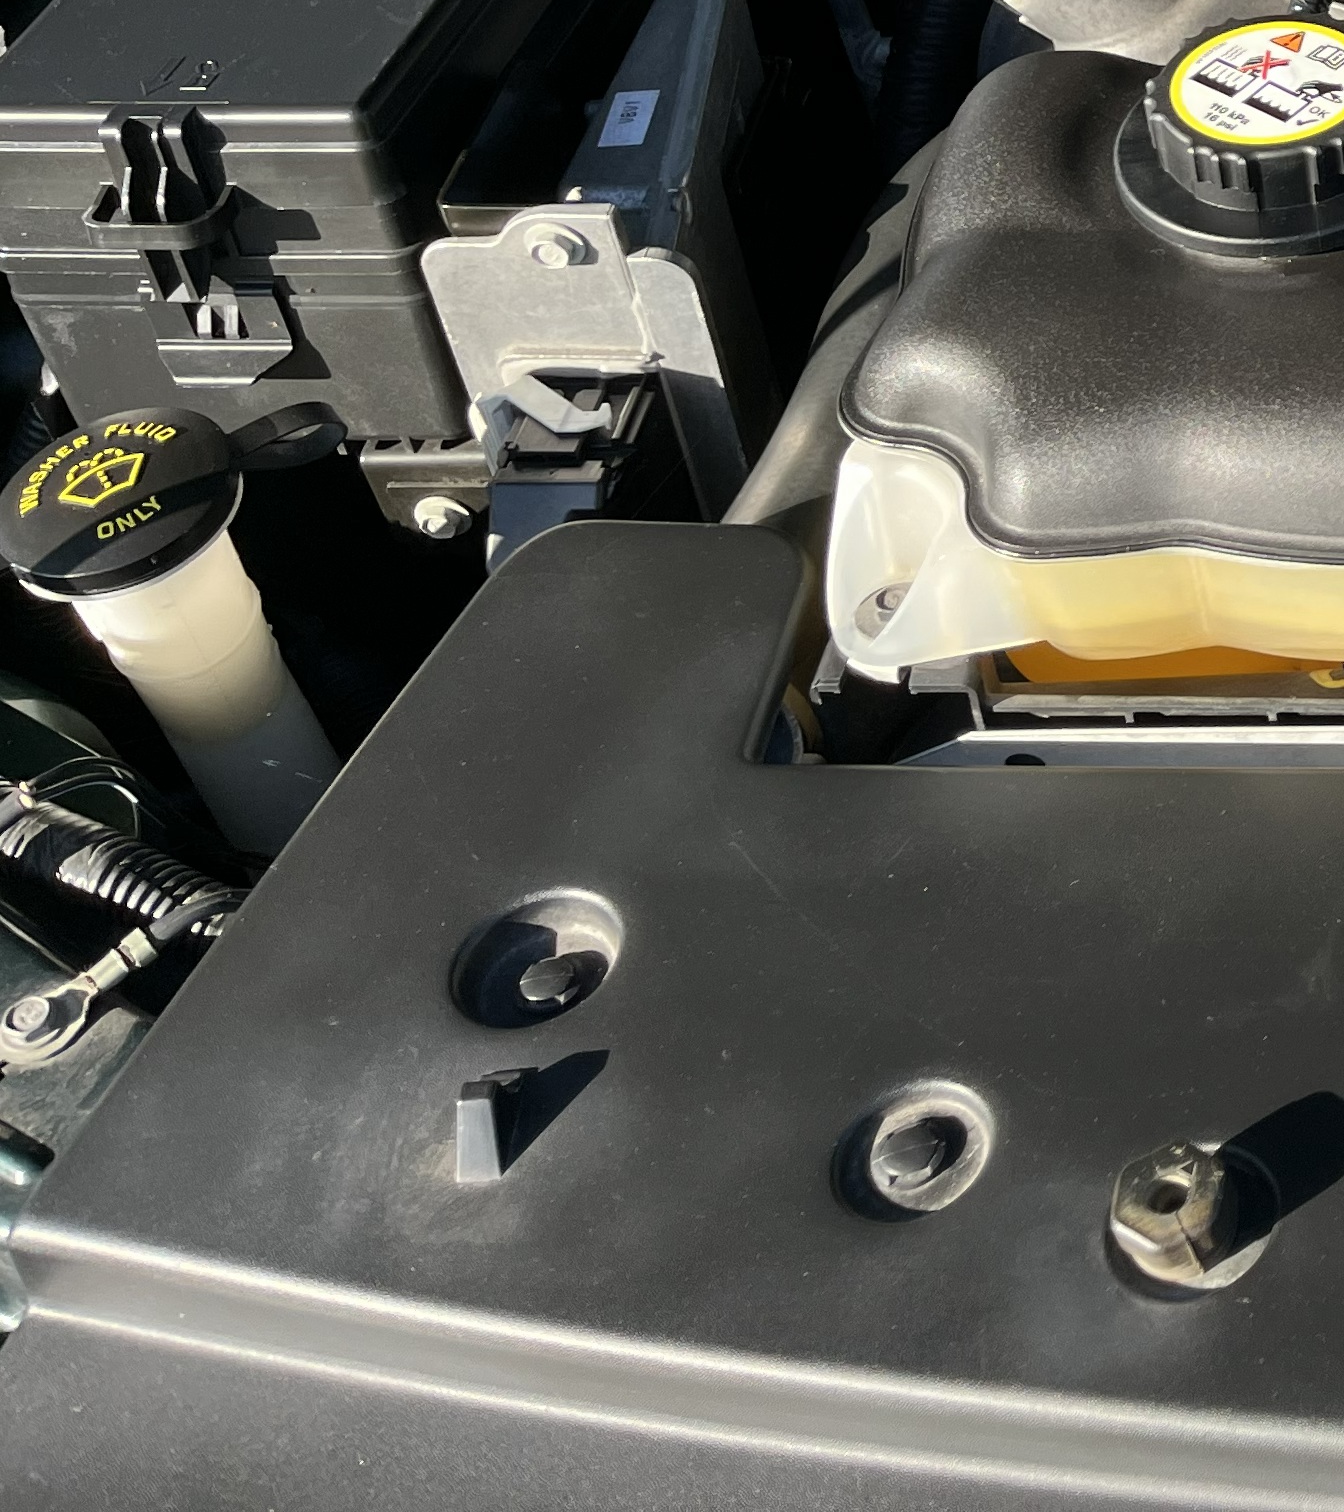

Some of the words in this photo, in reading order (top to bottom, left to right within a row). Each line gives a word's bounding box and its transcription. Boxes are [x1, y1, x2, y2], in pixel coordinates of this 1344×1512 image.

[1204, 112, 1216, 122] 16
[1217, 118, 1238, 131] psi
[1228, 110, 1249, 125] kPa
[1309, 106, 1330, 119] OK
[19, 434, 90, 518] WASHER
[104, 421, 177, 443] FLUID
[96, 495, 162, 540] ONLY
